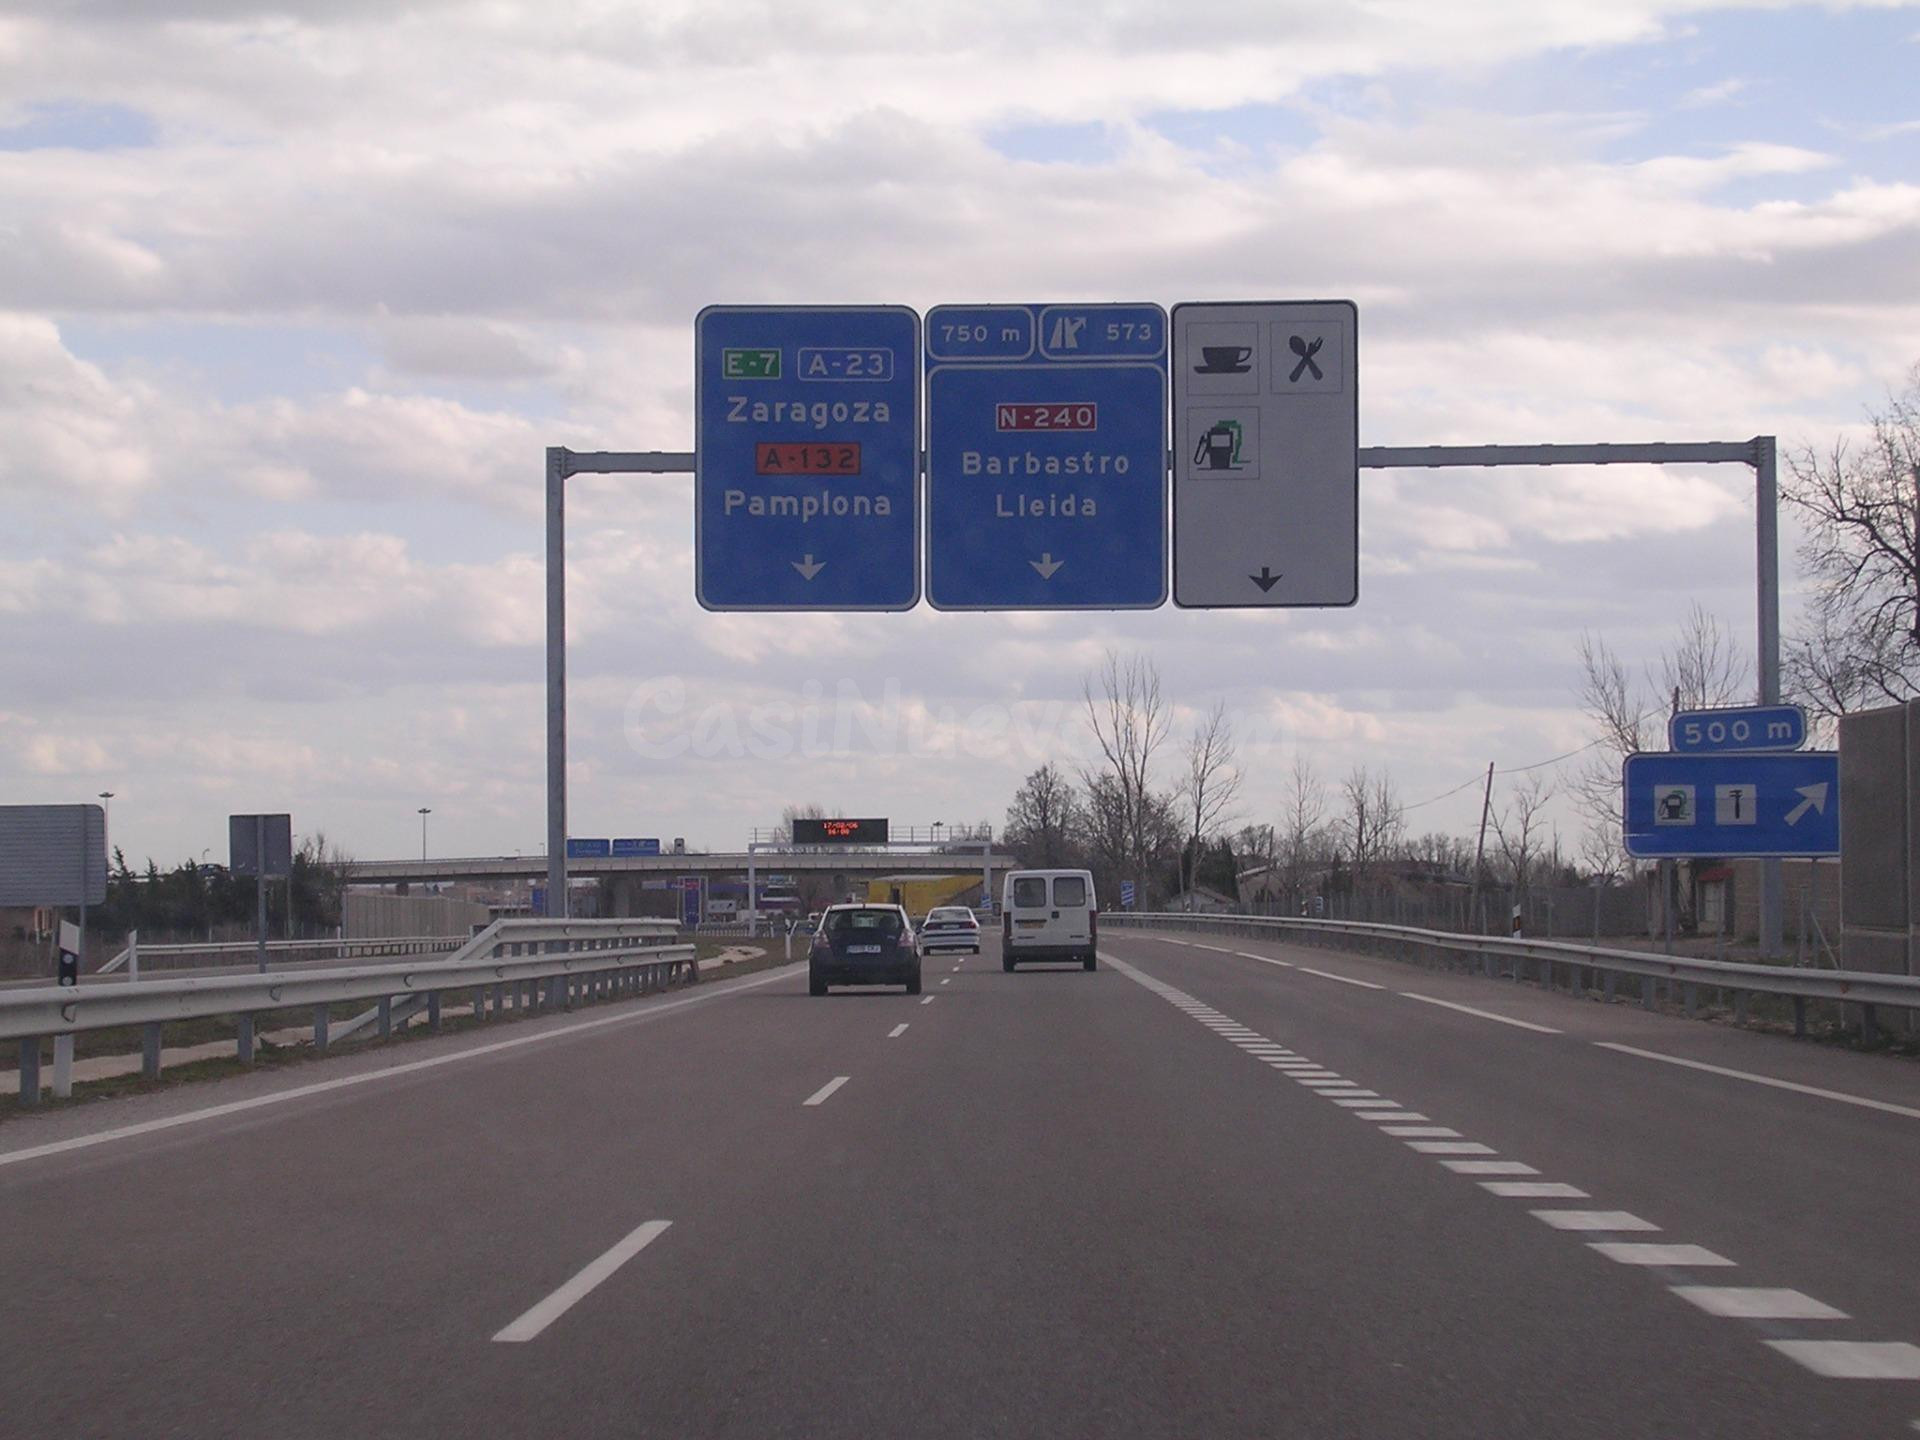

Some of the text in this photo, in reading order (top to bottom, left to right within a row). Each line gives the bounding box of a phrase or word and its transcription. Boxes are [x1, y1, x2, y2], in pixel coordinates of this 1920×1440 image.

[941, 325, 1020, 342] 750 m
[1106, 323, 1152, 340] 573
[727, 353, 777, 375] E-7
[808, 354, 884, 375] A-23
[727, 396, 890, 429] Zaragoza
[1000, 407, 1092, 427] N-240
[763, 448, 854, 469] A-132
[962, 451, 1130, 475] Barbastro
[724, 490, 891, 523] Pamplona
[996, 494, 1097, 517] Lleida
[1685, 720, 1792, 744] 500 m
